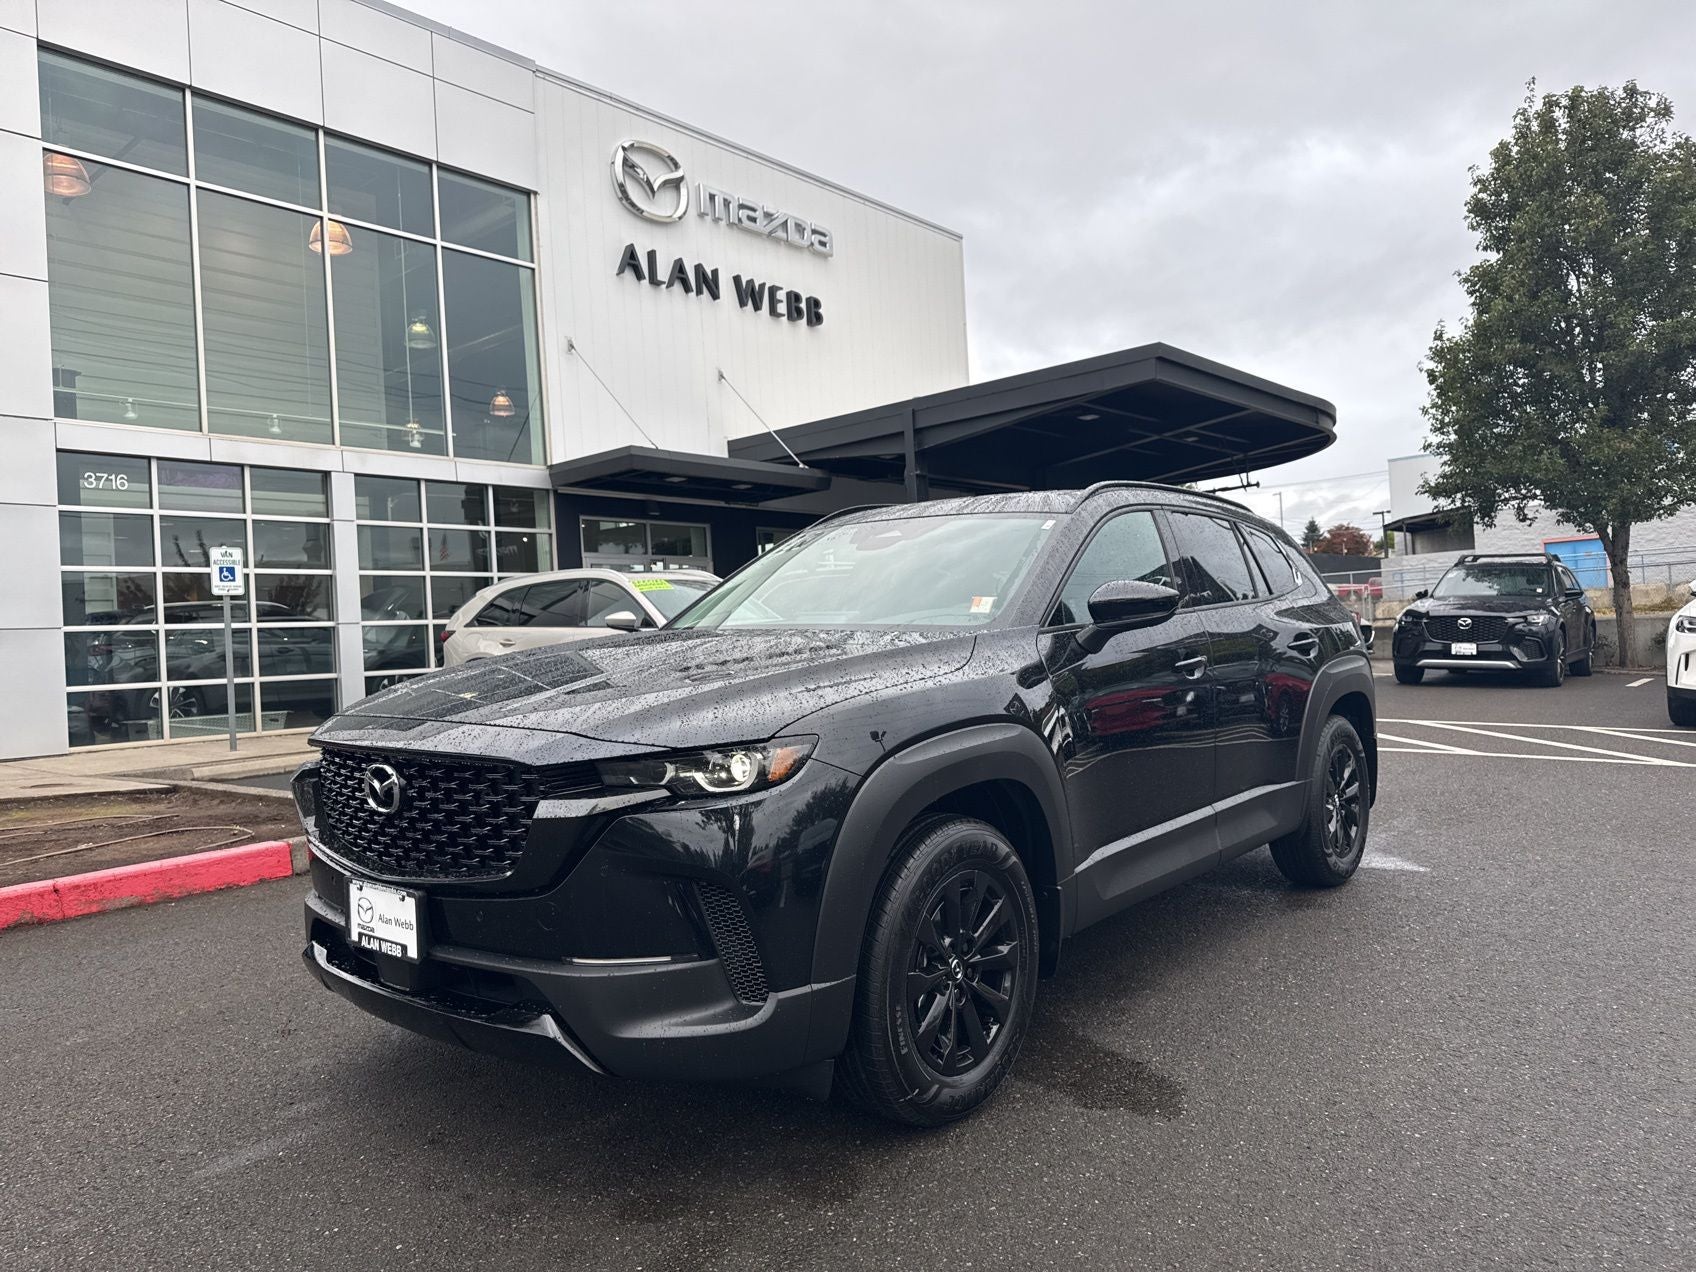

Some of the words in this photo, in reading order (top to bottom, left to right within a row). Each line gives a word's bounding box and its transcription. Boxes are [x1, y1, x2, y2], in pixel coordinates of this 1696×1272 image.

[616, 243, 720, 300] ALAN
[732, 274, 824, 327] WEBB
[84, 472, 128, 490] 3716
[378, 913, 392, 926] Alan
[394, 916, 414, 931] Webb
[361, 935, 379, 951] ALAN
[380, 940, 402, 958] WEBB
